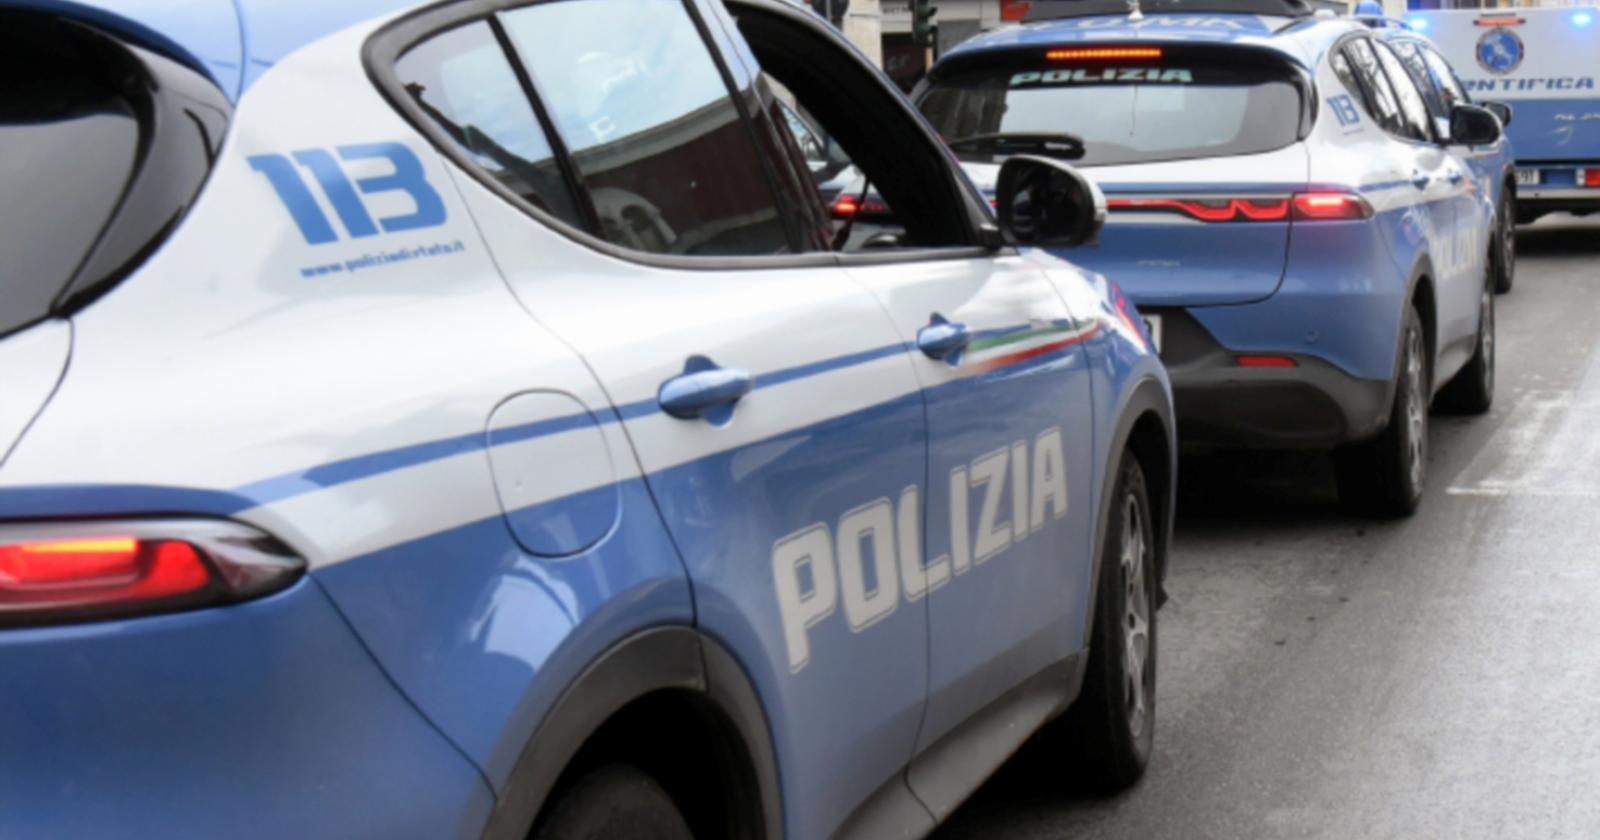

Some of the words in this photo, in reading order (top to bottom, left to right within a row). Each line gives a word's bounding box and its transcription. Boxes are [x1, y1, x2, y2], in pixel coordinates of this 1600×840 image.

[1008, 68, 1193, 86] POLIZIA
[245, 141, 448, 246] 113
[772, 425, 1068, 674] POLIZIA
